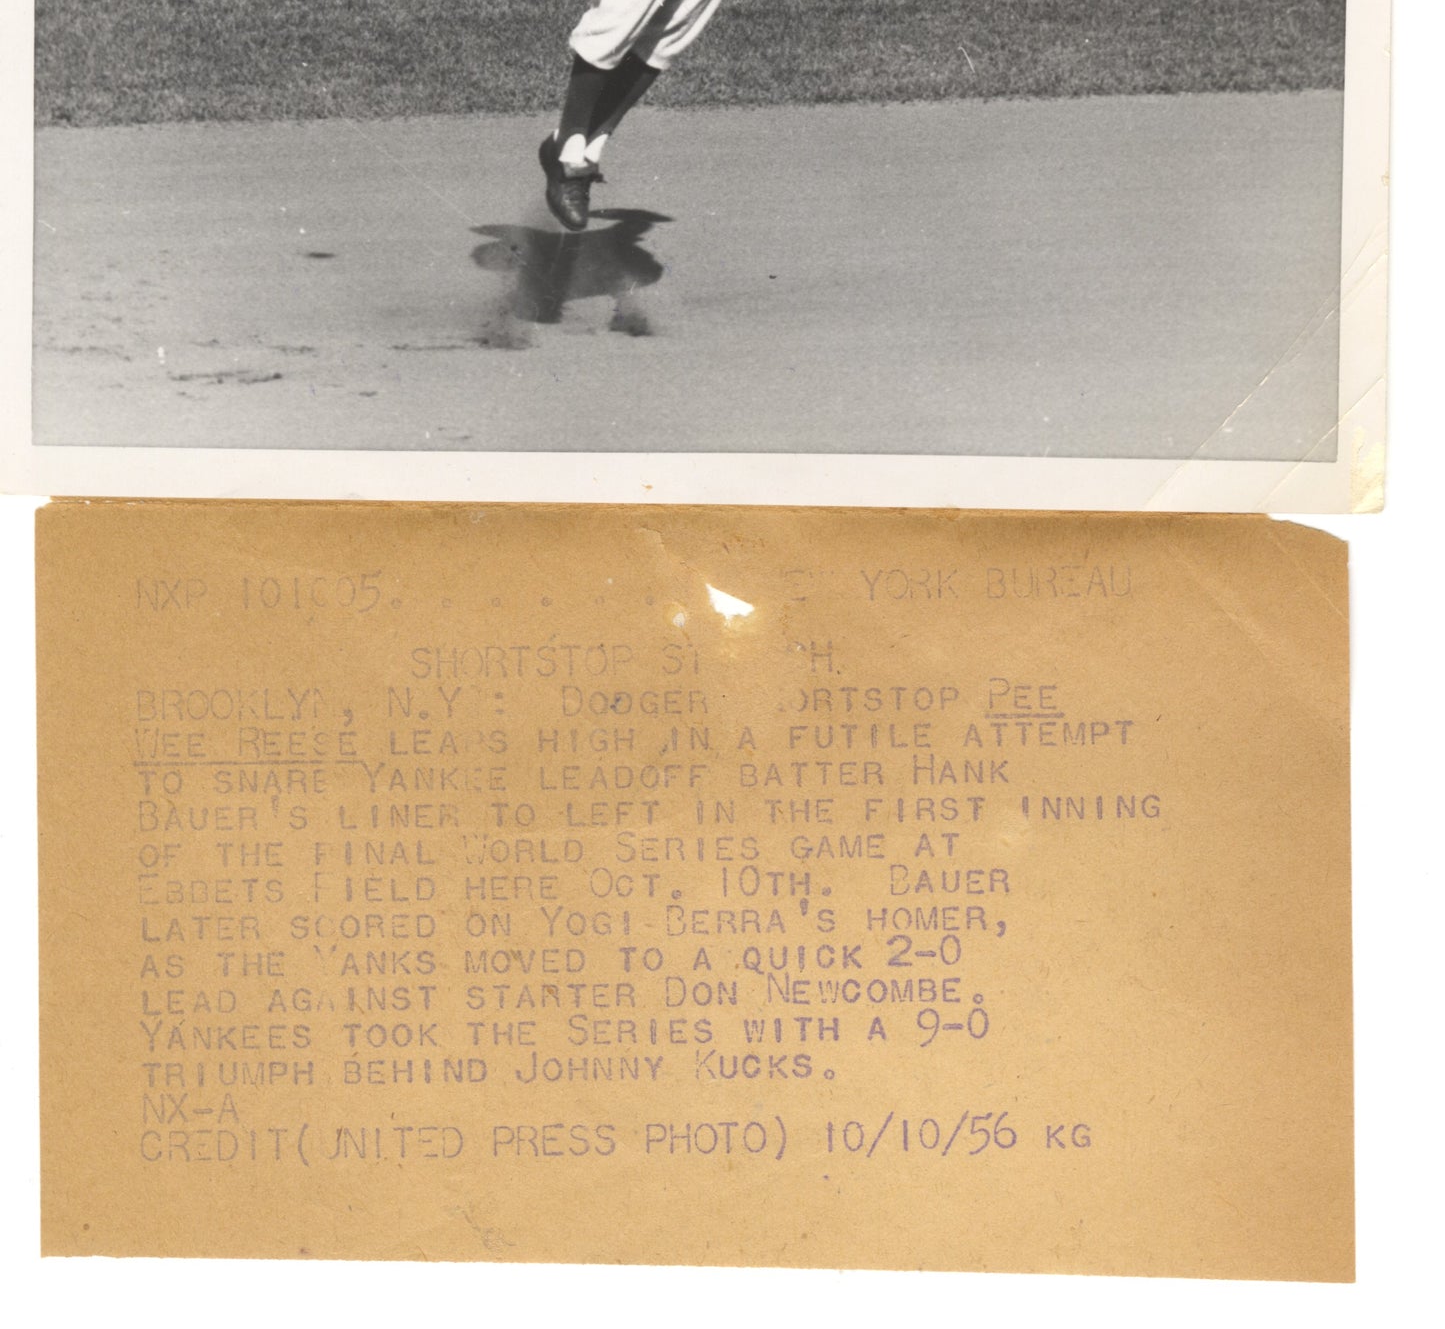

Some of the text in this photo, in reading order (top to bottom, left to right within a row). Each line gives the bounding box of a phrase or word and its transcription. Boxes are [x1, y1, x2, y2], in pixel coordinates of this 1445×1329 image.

[135, 578, 207, 610] NXP
[860, 568, 960, 601] YORK
[986, 565, 1133, 599] BUREAU
[410, 645, 634, 680] SHORTSTOP
[561, 684, 710, 718] DODGER
[987, 677, 1059, 713] PEE
[134, 727, 207, 761] WEE
[238, 726, 358, 758] REESE
[538, 728, 636, 755] HIGH
[671, 726, 711, 751] IN
[737, 725, 758, 751] A
[789, 723, 933, 750] FUTILE
[963, 719, 1135, 748] ATTEMPT
[139, 754, 1010, 796] TO SNARE YANKEE LEADOFF BATTER HANK
[139, 794, 1162, 833] BAUER'S LINER TO LEFT IN THE FIRST INNING
[138, 843, 183, 869] OF
[216, 841, 284, 868] THE
[314, 839, 437, 867] FINAL
[615, 831, 760, 863] SERIES
[790, 834, 886, 861] GAME
[914, 832, 961, 858] AT
[139, 864, 1011, 906] EBBETS FIELD HERE OCT. 10TH. BAUER
[141, 897, 1008, 943] LATER SCORED ON YOGI BERRA'S HOMER,
[140, 954, 185, 979] AS
[216, 951, 286, 977] THE
[464, 948, 587, 974] MOVED
[619, 947, 665, 972] TO
[693, 946, 712, 971] A
[742, 944, 863, 974] QUICK
[886, 934, 962, 969] 2-0
[141, 989, 238, 1017] LEAD
[466, 982, 637, 1011] STARTER
[666, 976, 738, 1008] DON
[767, 971, 986, 1006] NEWCOMBE.
[139, 1007, 990, 1052] YANKEES TOOK THE SERIES WITH A 9-0
[142, 1049, 836, 1089] TRIUMPH BEHIND JOHNNY KUCKS.
[142, 1093, 241, 1125] NX-A
[492, 1124, 617, 1158] PRESS
[646, 1116, 787, 1160] PHOTO)
[826, 1110, 1018, 1158] 10/10/56
[1045, 1123, 1093, 1149] KG
